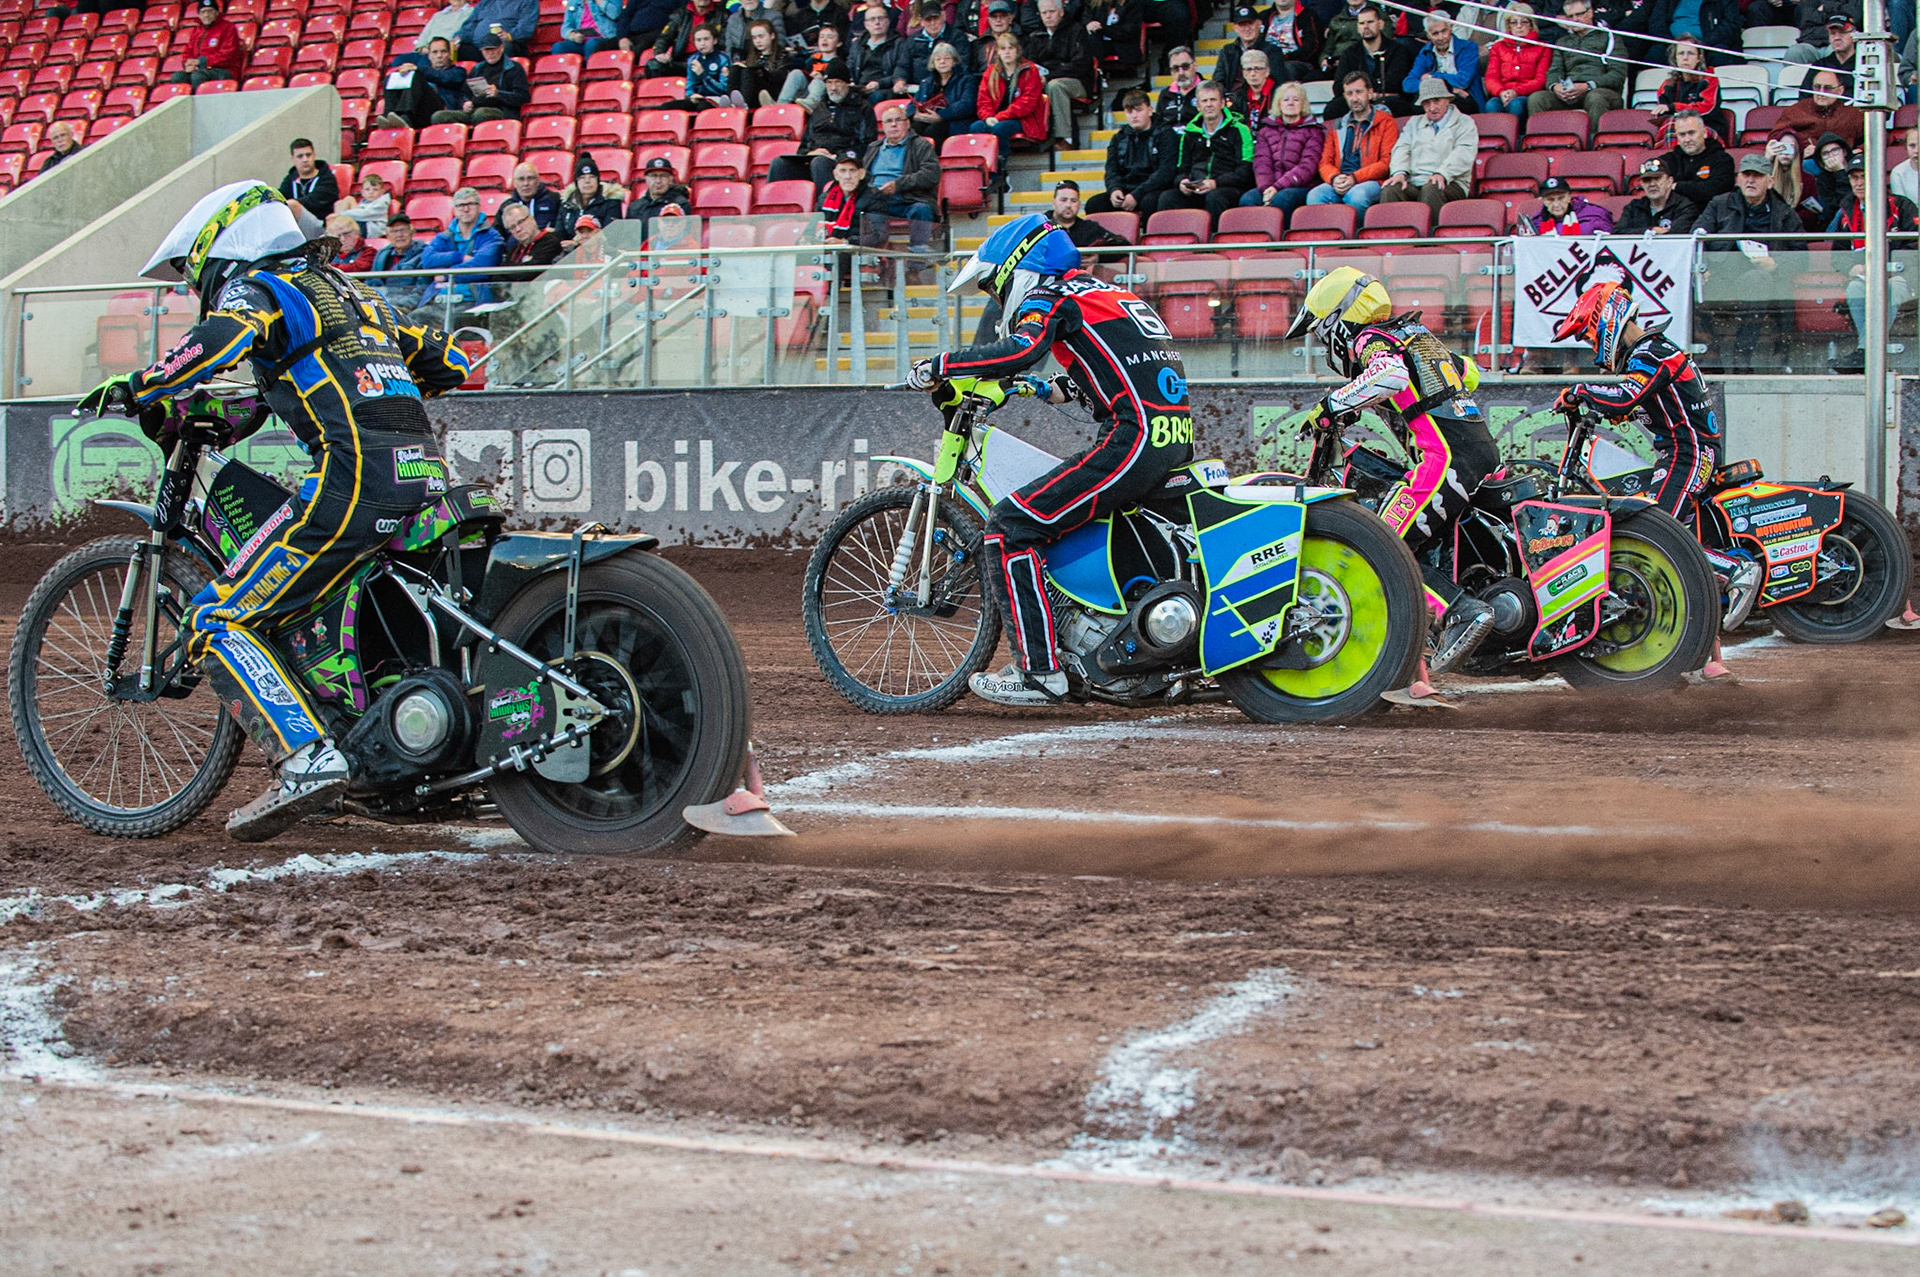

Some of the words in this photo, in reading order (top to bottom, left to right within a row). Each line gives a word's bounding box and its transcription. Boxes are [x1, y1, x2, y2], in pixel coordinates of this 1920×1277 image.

[1523, 241, 1590, 307] BELLE
[1628, 244, 1675, 299] VUE
[214, 485, 234, 497] Louise
[232, 512, 253, 526] Megan
[1755, 516, 1813, 537] MOTORVATION
[1251, 542, 1286, 564] RRE
[1779, 543, 1808, 556] Castrol
[254, 561, 291, 599] RACING
